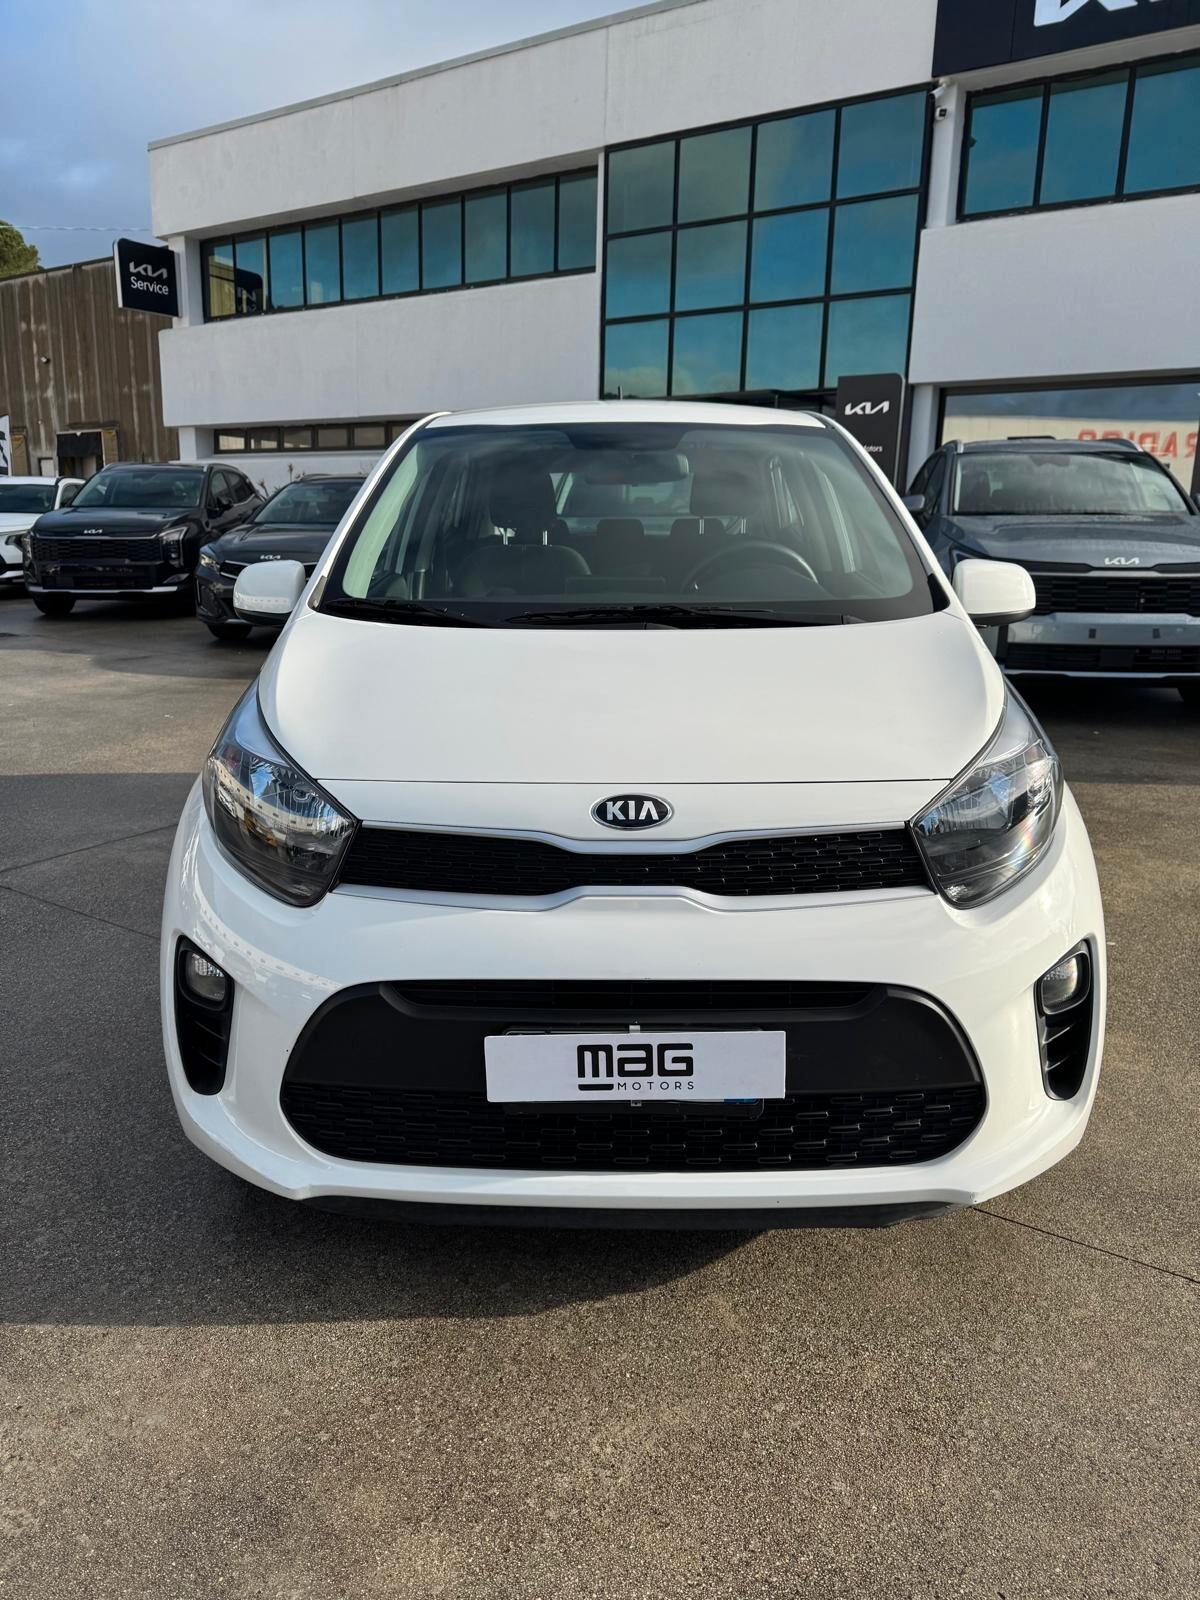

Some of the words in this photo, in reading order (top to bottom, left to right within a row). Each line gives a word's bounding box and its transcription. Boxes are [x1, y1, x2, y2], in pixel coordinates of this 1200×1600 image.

[129, 261, 168, 279] KIA
[130, 276, 169, 295] Service
[844, 400, 890, 416] KIA
[1104, 557, 1140, 565] KIA
[606, 800, 660, 821] KIA
[617, 1081, 694, 1091] MOTORS
